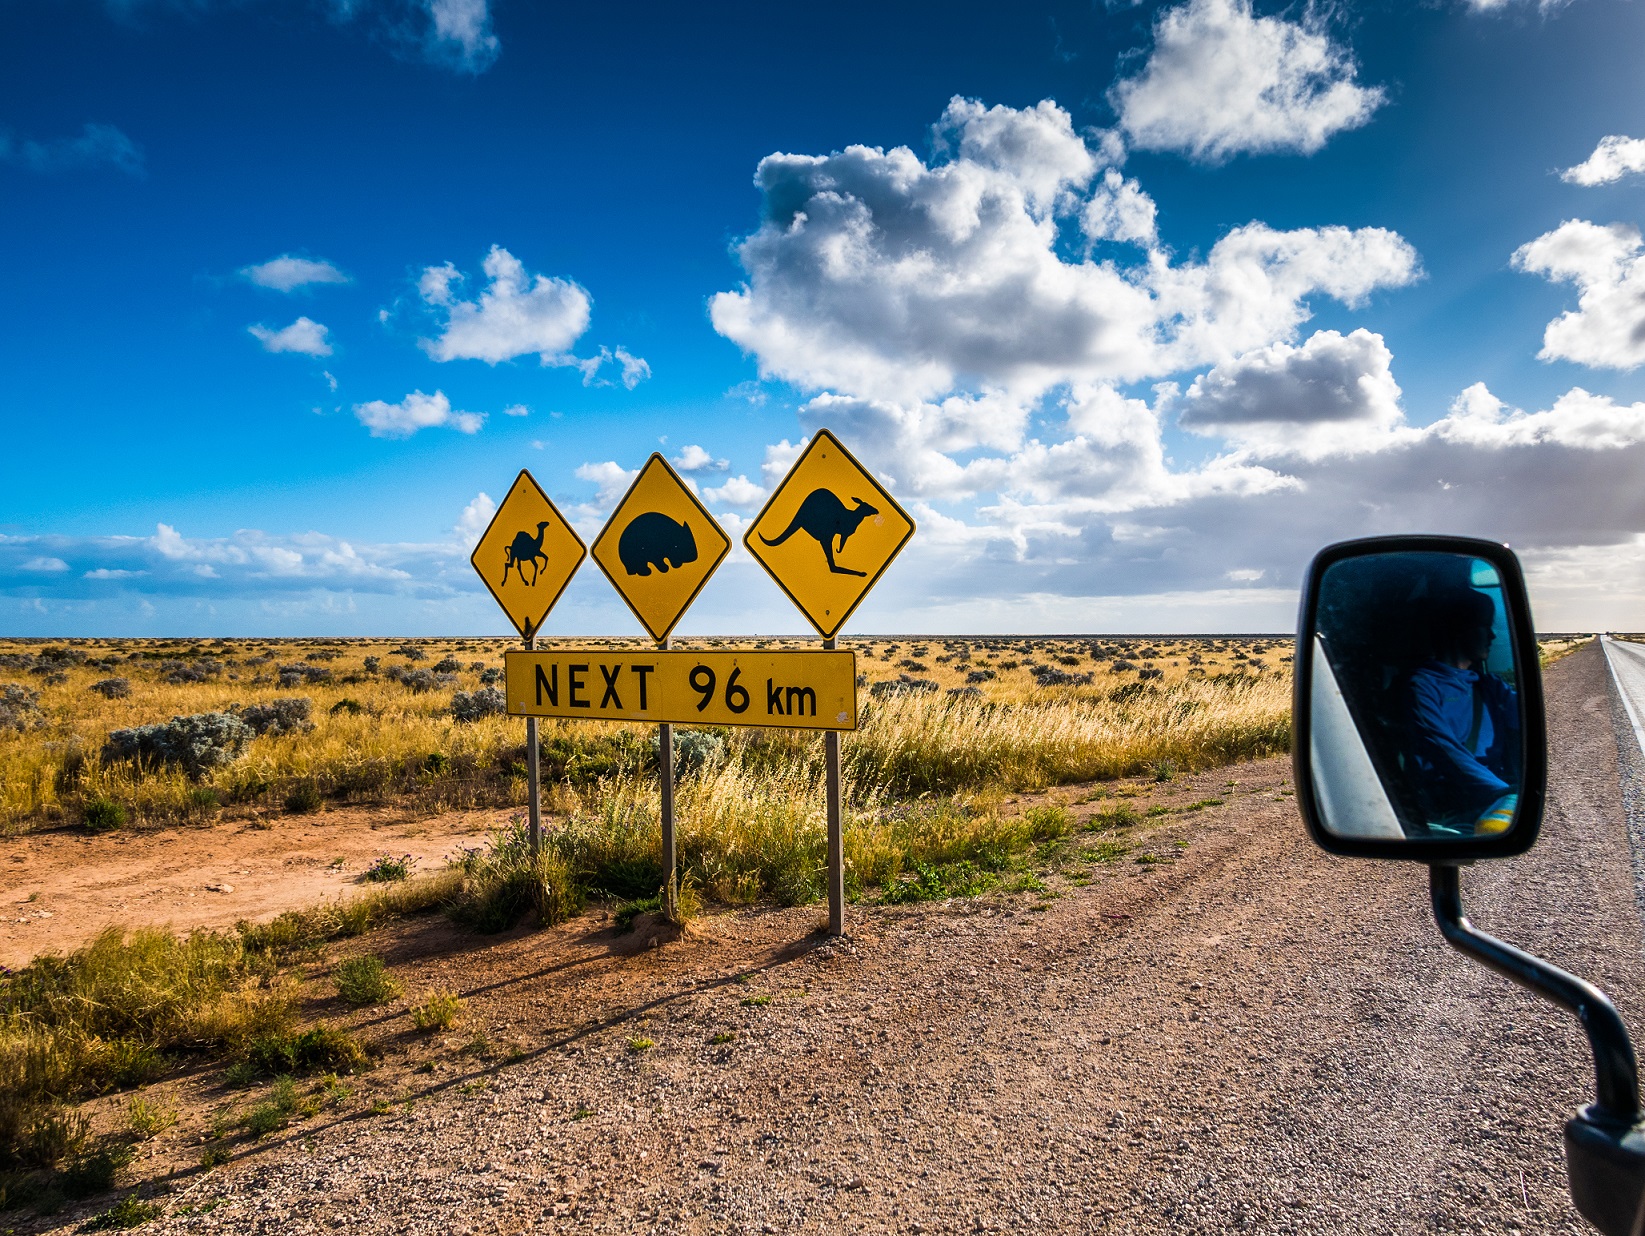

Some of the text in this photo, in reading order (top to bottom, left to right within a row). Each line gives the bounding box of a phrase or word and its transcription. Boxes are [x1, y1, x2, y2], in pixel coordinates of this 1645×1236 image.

[535, 664, 817, 717] NEXT 96 km
